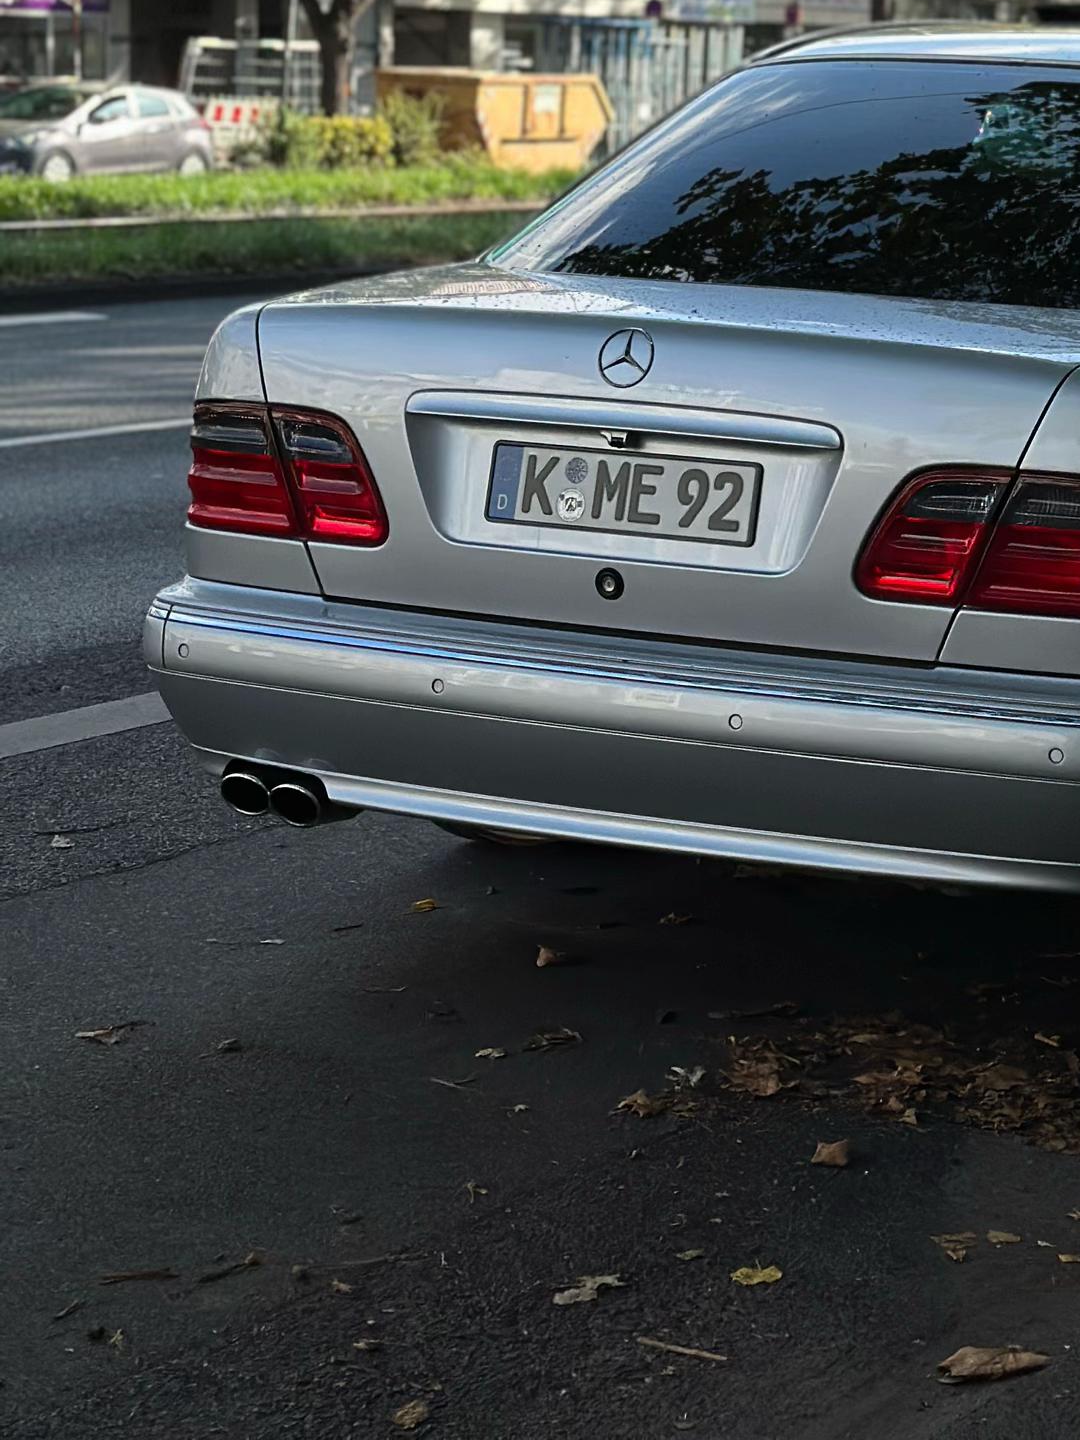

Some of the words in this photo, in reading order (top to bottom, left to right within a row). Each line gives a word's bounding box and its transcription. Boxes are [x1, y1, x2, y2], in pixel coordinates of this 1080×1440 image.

[497, 493, 508, 510] D
[521, 454, 561, 516] K
[591, 459, 665, 526] ME
[677, 468, 744, 533] 92
